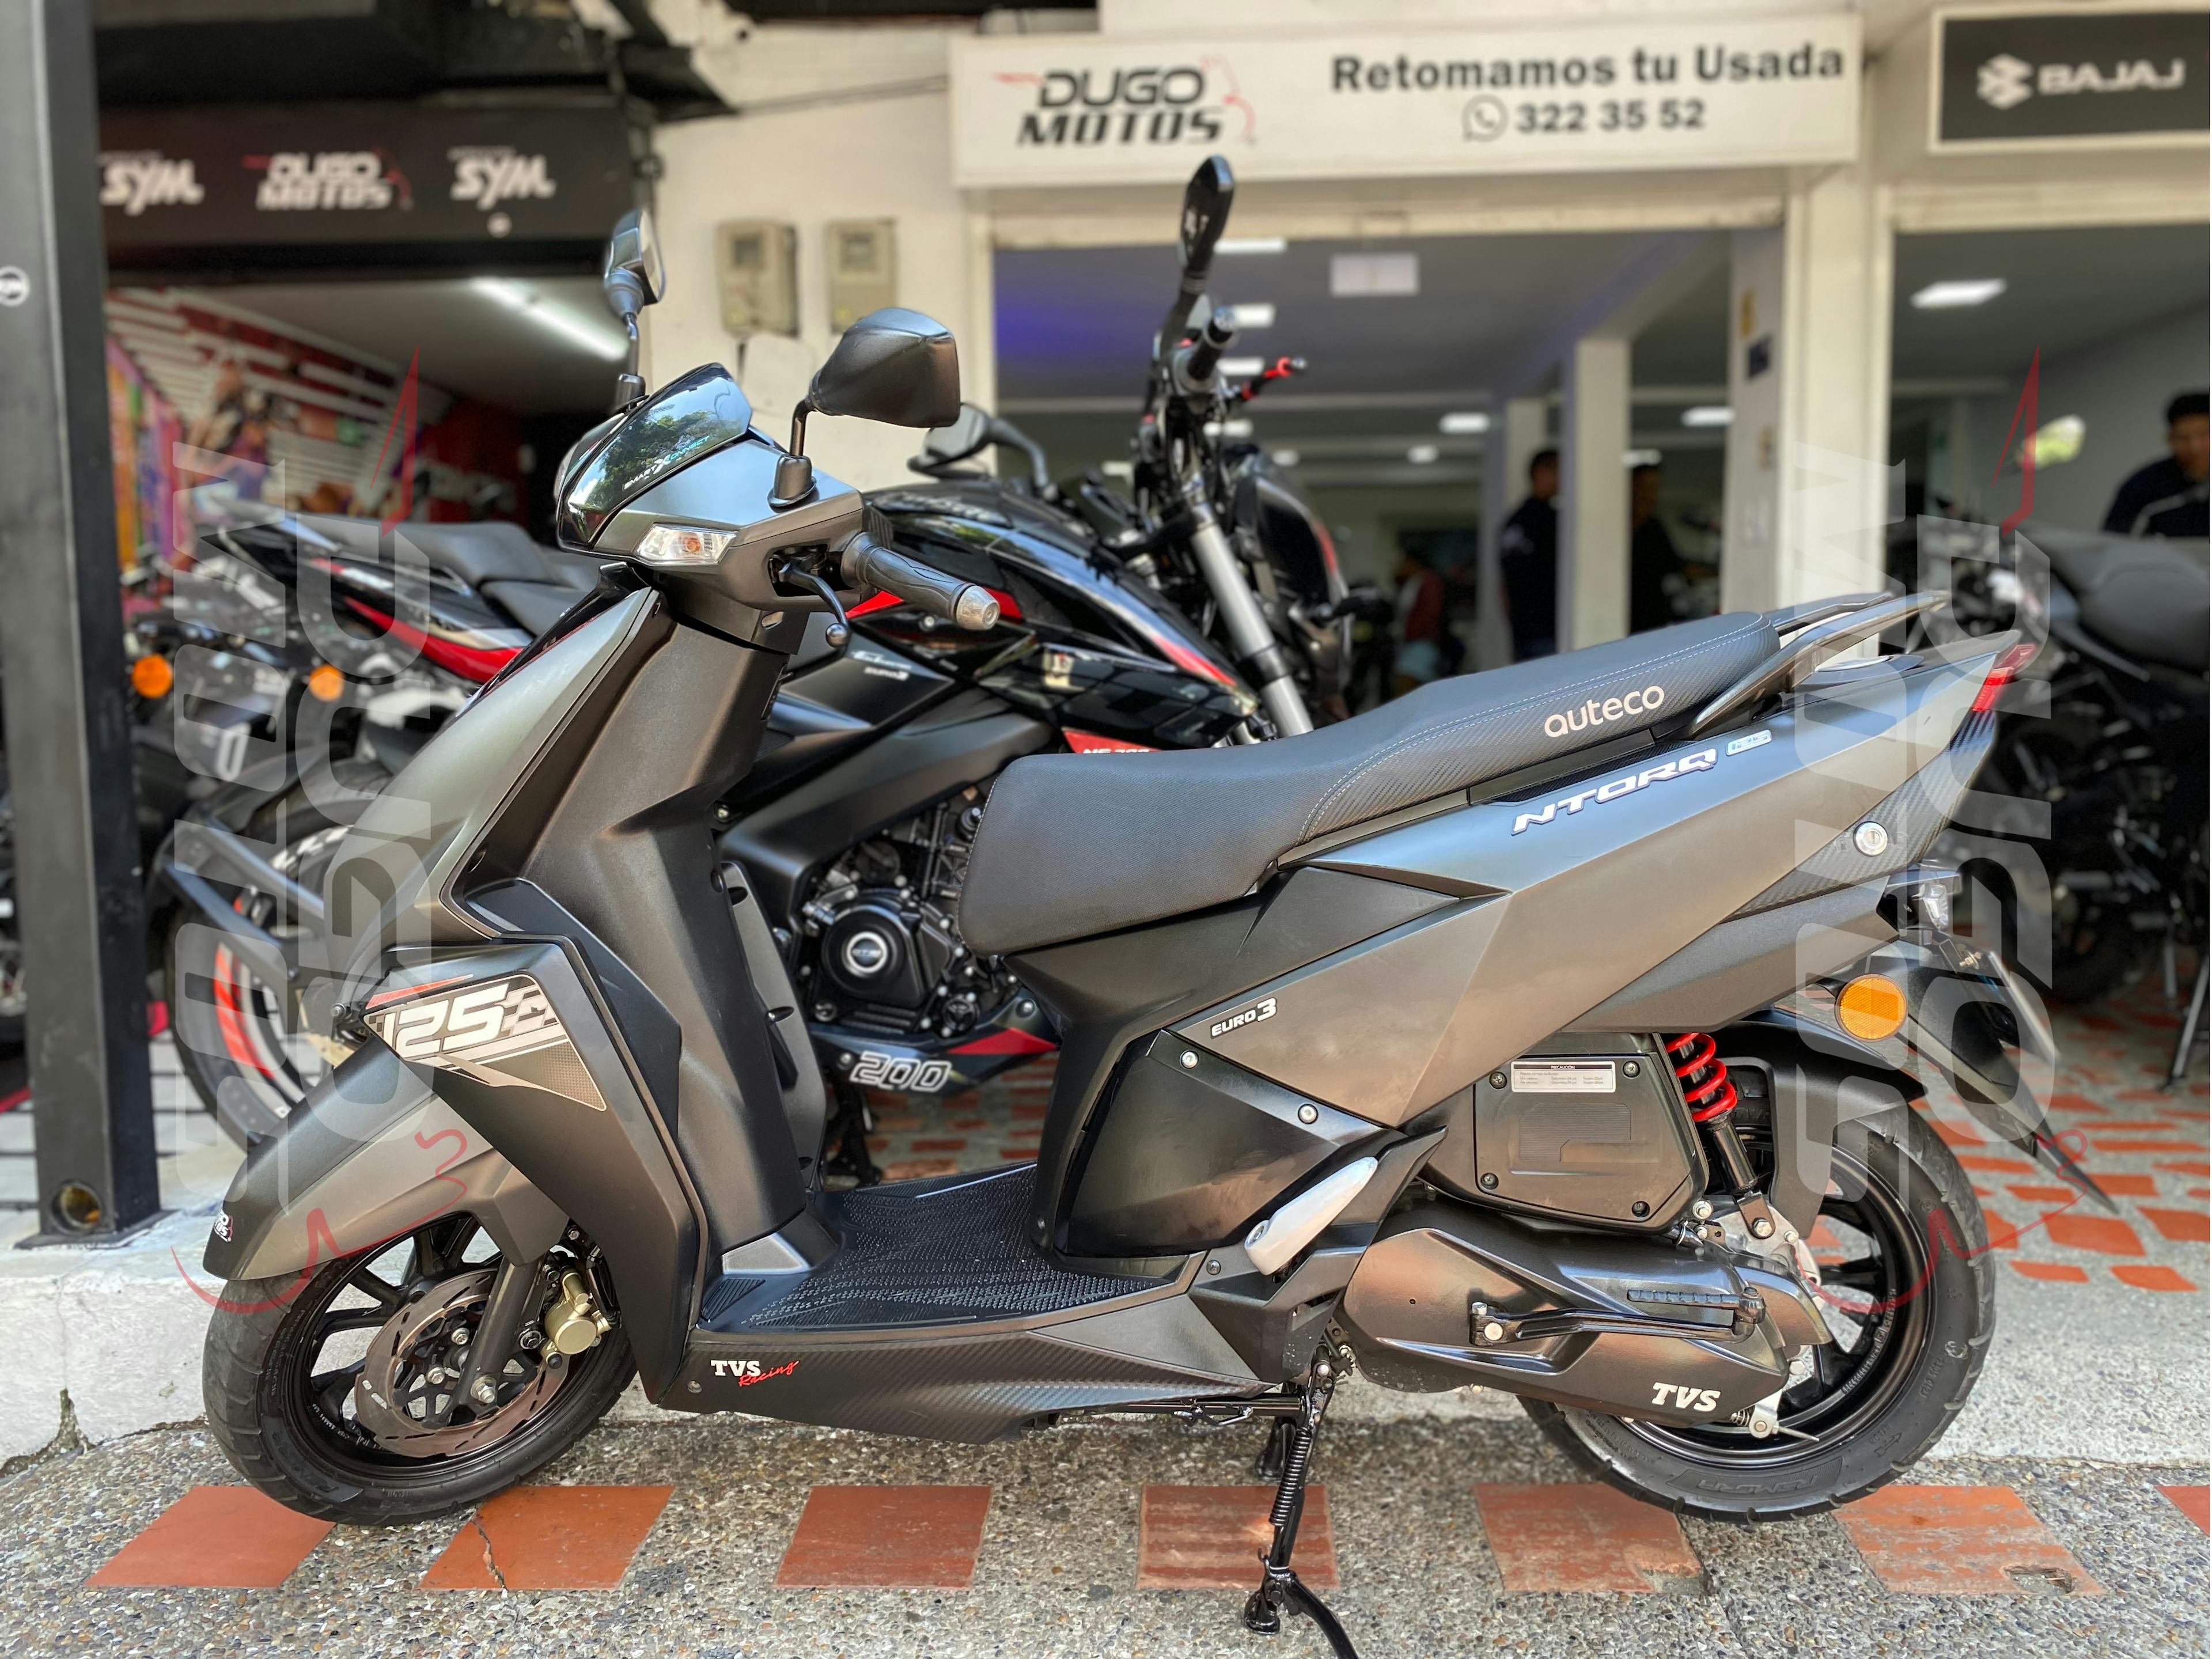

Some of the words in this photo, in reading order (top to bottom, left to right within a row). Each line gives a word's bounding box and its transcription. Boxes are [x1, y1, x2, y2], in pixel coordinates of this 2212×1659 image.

[1331, 55, 1616, 93] Retomamos
[1633, 47, 1679, 83] tu
[1695, 41, 1844, 82] Usada
[2038, 58, 2187, 96] BAJAJ
[1037, 66, 1205, 109] DUGO
[1017, 108, 1223, 147] MOTOS
[1515, 103, 1586, 134] 322
[1598, 100, 1646, 131] 35
[1658, 99, 1707, 129] 52
[1544, 685, 1665, 738] auteco
[1729, 731, 1770, 755] 125
[1512, 748, 1718, 835] NTORQ
[382, 983, 512, 1054] 125
[850, 1051, 952, 1093] 200
[710, 1359, 762, 1377] TVS
[738, 1360, 800, 1387] Racing
[1652, 1381, 1721, 1412] TVS
